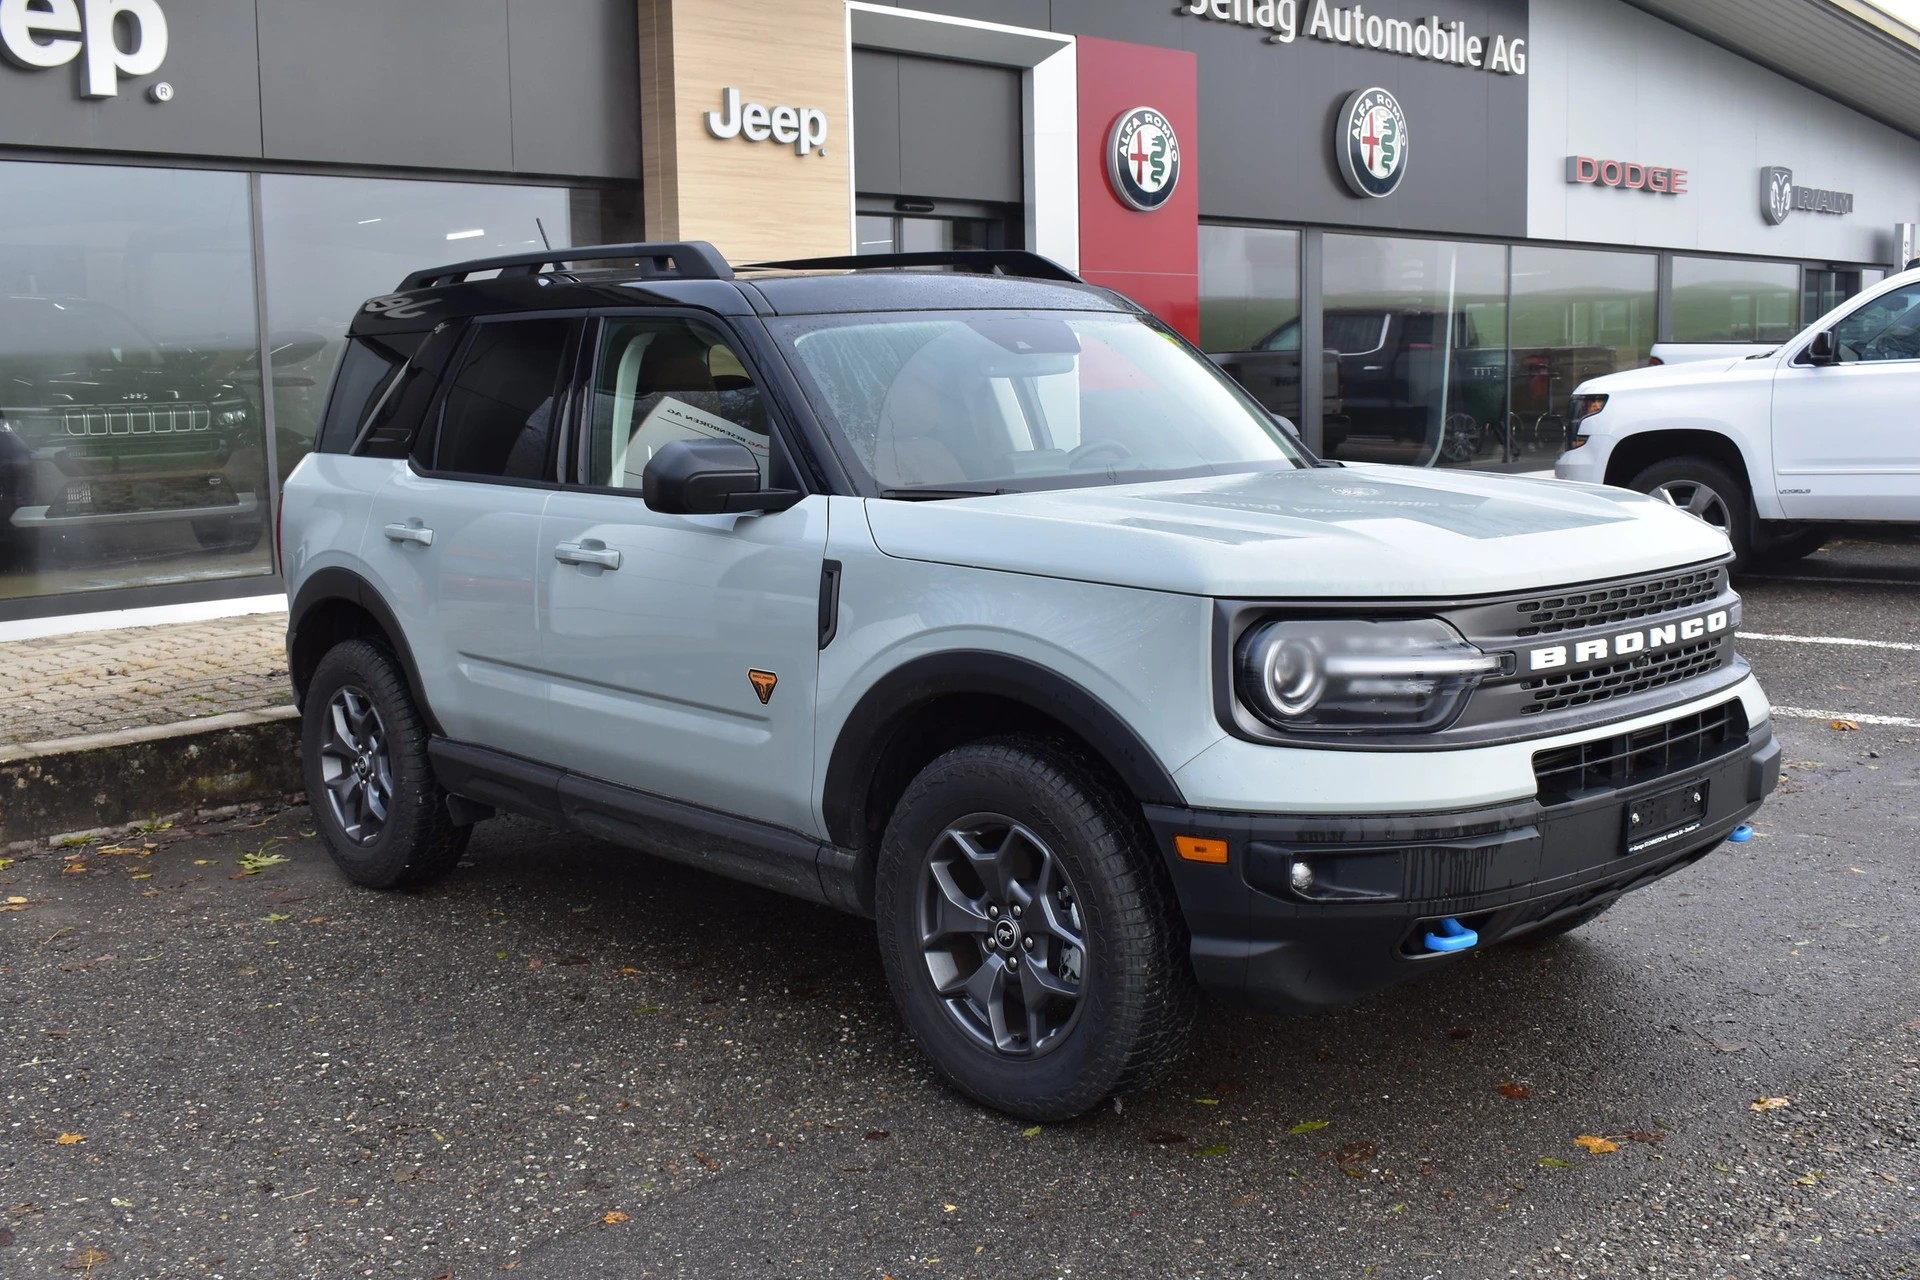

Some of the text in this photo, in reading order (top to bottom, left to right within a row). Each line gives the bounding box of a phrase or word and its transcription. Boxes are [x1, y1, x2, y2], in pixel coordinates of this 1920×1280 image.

[1310, 0, 1482, 67] Automobile
[1491, 34, 1526, 75] AG
[703, 87, 828, 156] Jeep
[1119, 113, 1178, 162] ALFA ROMEO
[1352, 94, 1406, 147] ALFA ROMEO
[1574, 155, 1688, 194] DODGE
[1796, 186, 1853, 214] RAM
[1530, 610, 1727, 671] BRONCO
